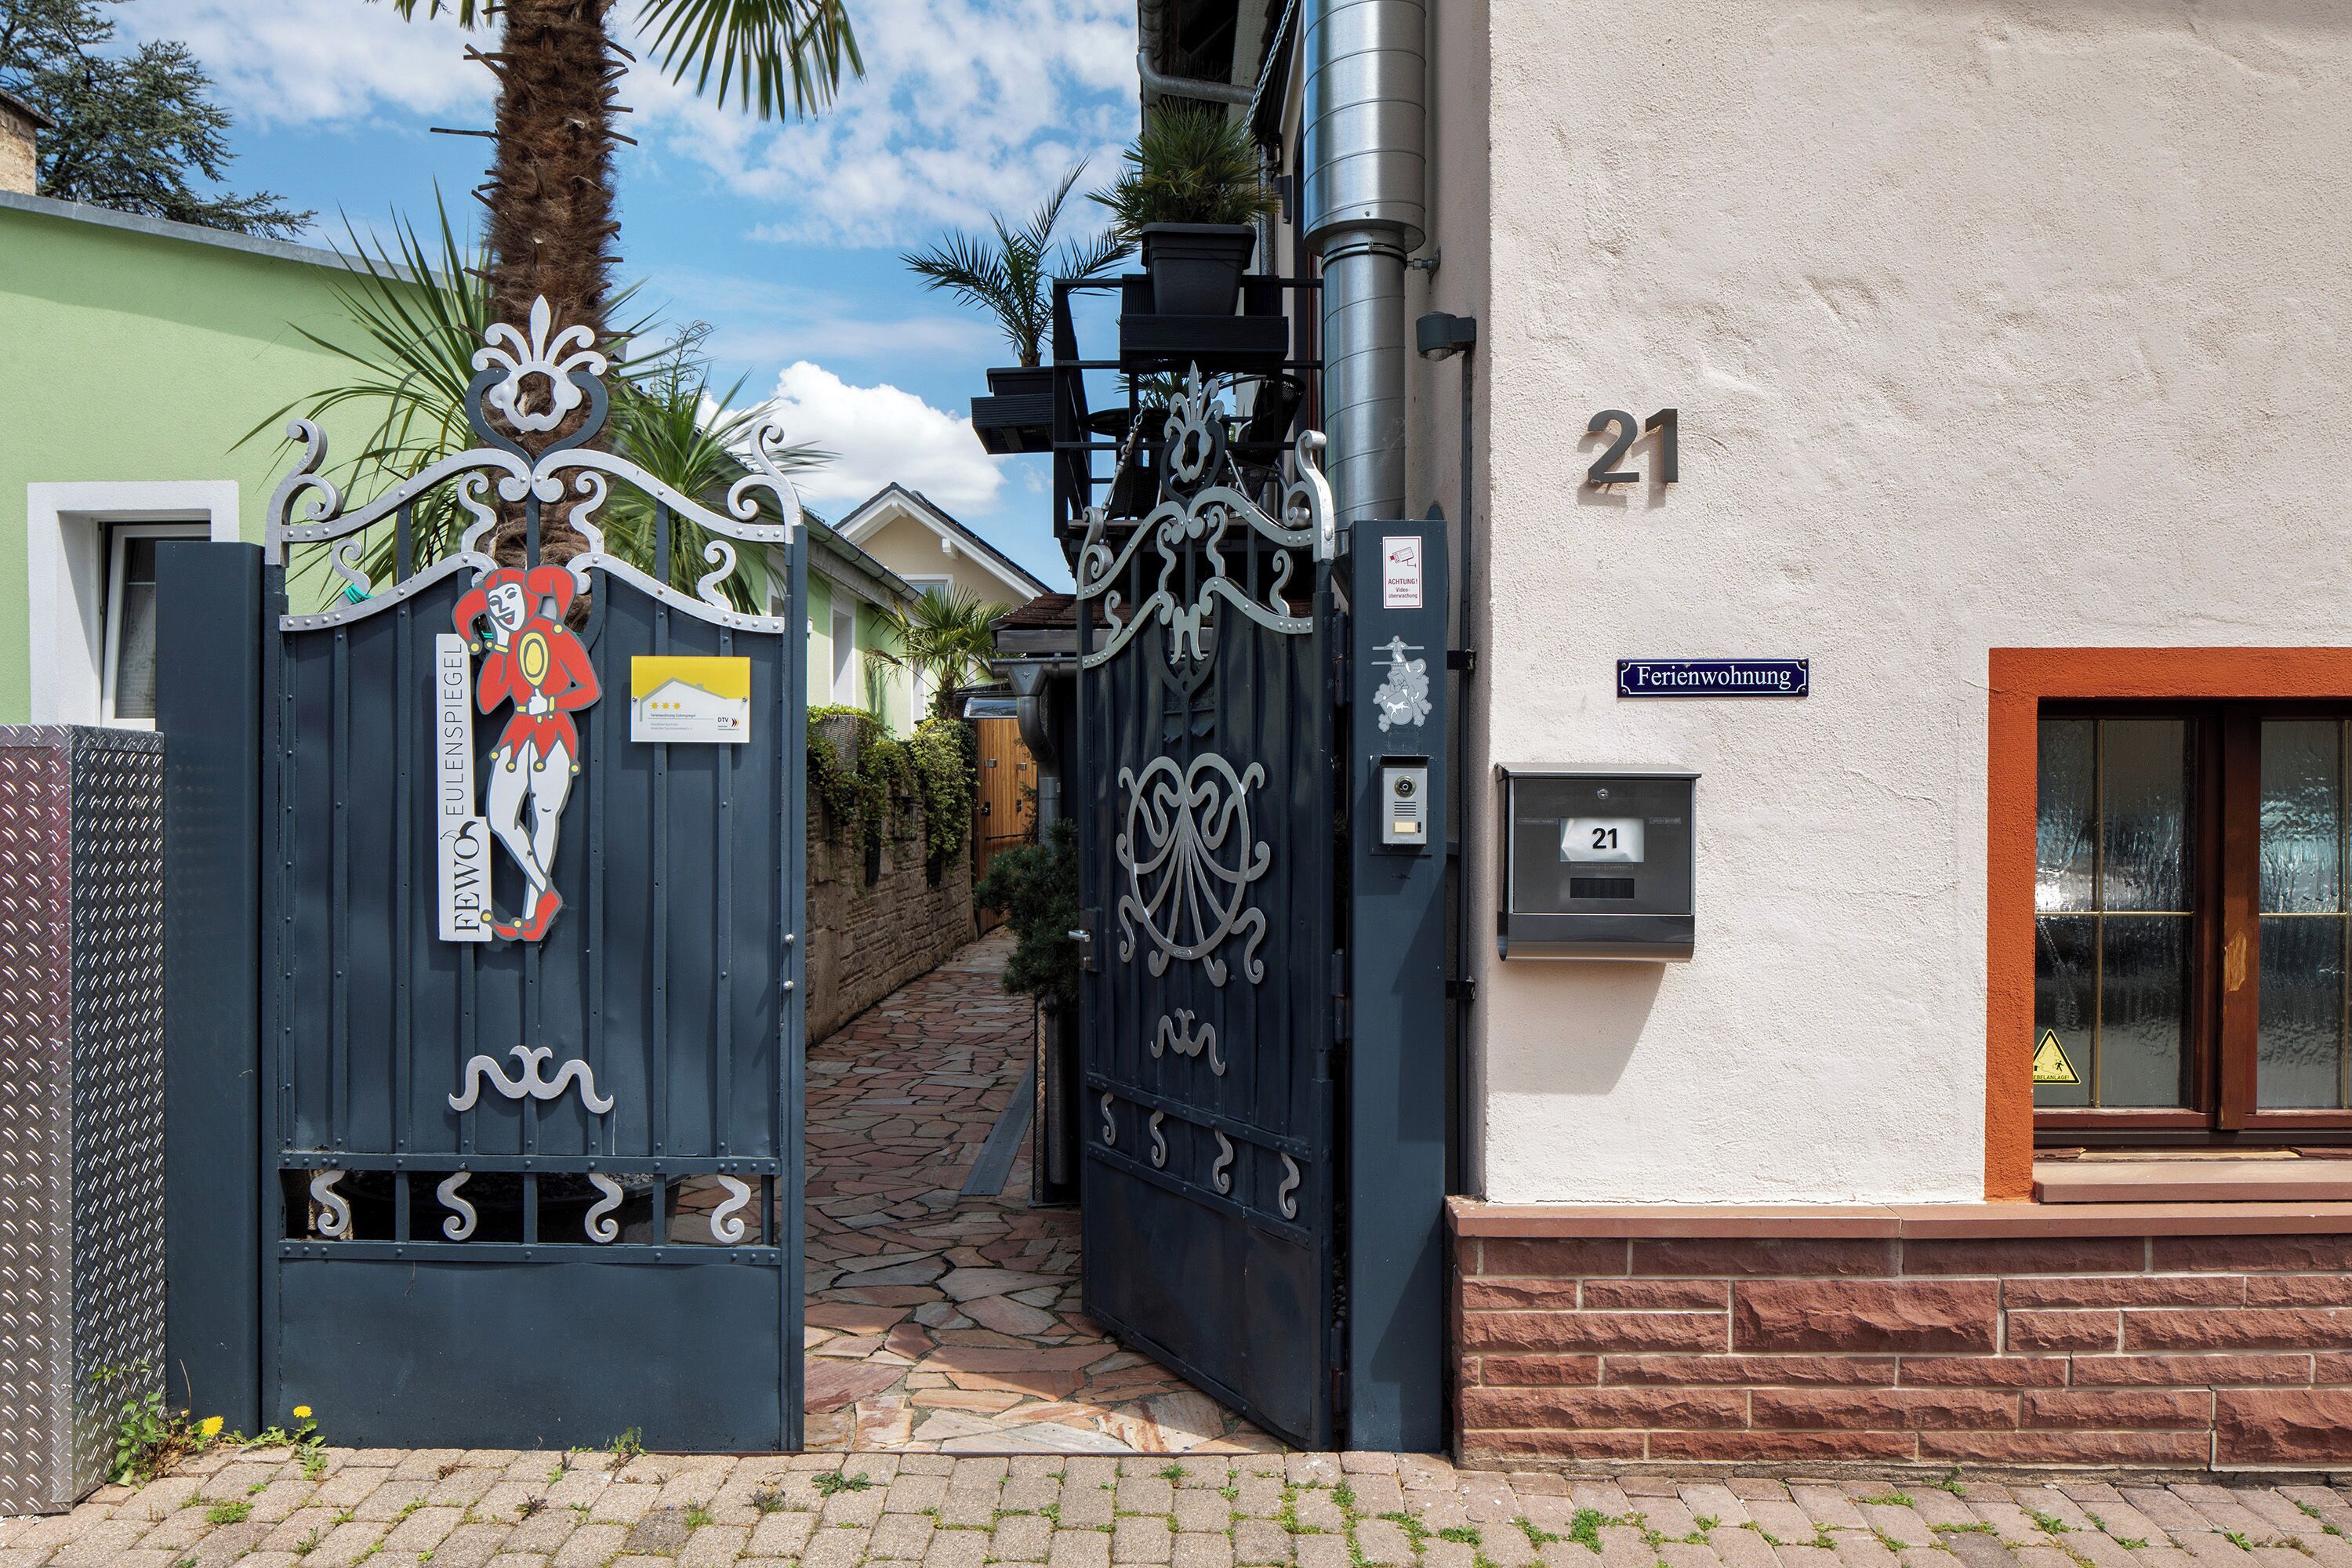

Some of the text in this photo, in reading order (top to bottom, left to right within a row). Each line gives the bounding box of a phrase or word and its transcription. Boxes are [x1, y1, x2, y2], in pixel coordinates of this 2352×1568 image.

[1588, 408, 1679, 483] 21
[1637, 665, 1791, 689] Ferienwohnung
[444, 643, 481, 933] FEWO EULENSPIEGEL
[1592, 827, 1618, 849] 21
